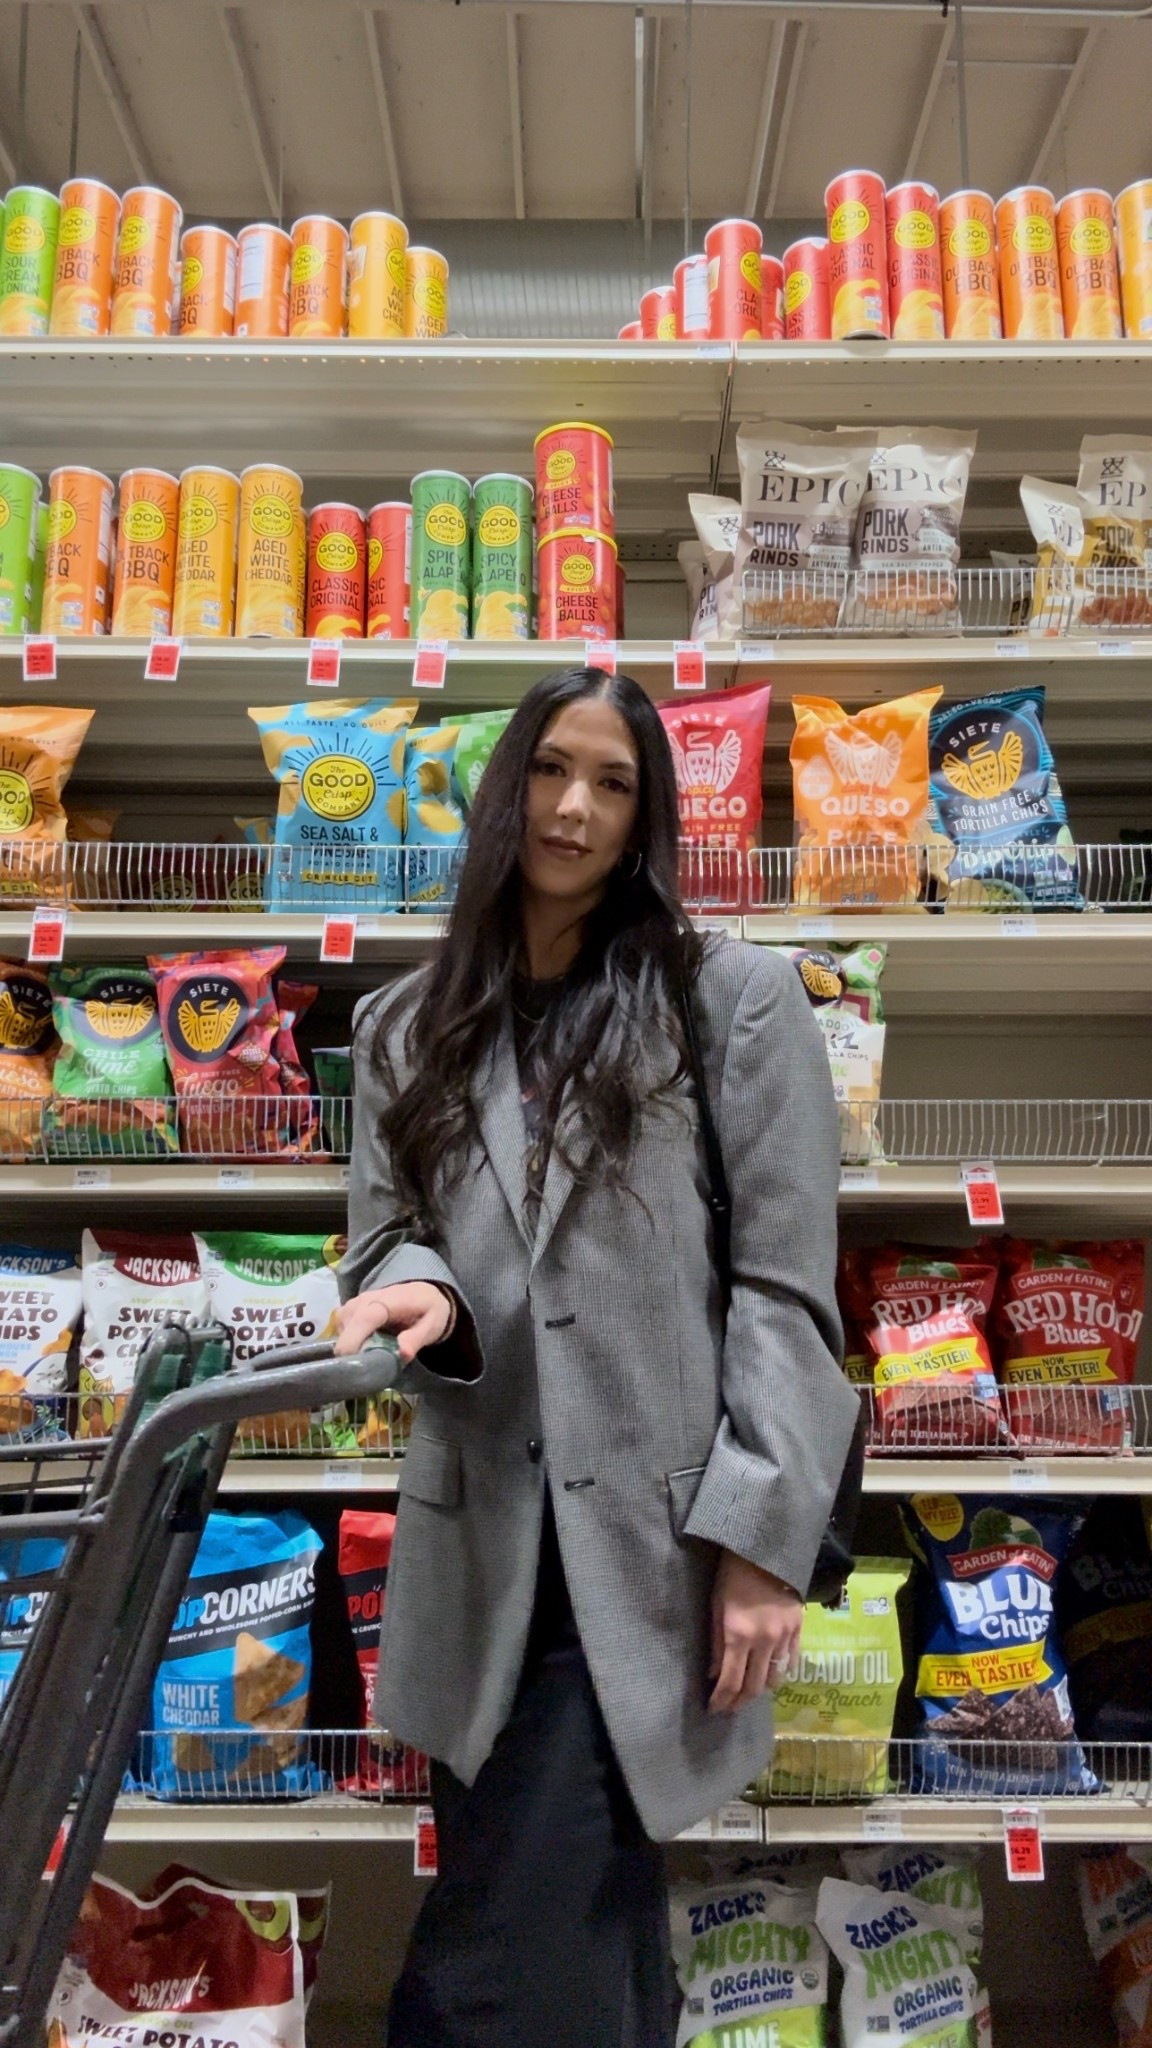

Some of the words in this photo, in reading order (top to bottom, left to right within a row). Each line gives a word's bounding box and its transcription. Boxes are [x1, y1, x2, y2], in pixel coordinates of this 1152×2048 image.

[5, 257, 38, 268] SOUR
[758, 473, 863, 507] EPIC
[865, 468, 963, 495] EPIC
[542, 488, 582, 507] CHEESE
[125, 513, 163, 524] GOOD
[253, 507, 291, 520] GOOD
[544, 500, 578, 519] BALLS
[481, 518, 518, 529] GOOD
[862, 508, 909, 539] PORK
[753, 521, 801, 550] PORK
[253, 539, 287, 555] AGED
[319, 544, 355, 555] GOOD
[861, 538, 909, 555] RINDS
[250, 555, 289, 573] WHITE
[564, 563, 591, 571] GOOD
[750, 548, 799, 567] RINDS
[122, 560, 160, 583] BBQ
[245, 568, 292, 586] CHEDDAR
[312, 577, 359, 595] CLASSIC
[310, 592, 360, 611] ORIGINAL
[556, 595, 599, 609] CHEESE
[559, 608, 596, 621] BALLS
[361, 719, 387, 728] GUILT
[672, 713, 727, 728] SIETE
[948, 722, 1001, 749] SIETE
[330, 765, 346, 774] The
[309, 773, 368, 788] GOOD
[323, 789, 352, 800] Crisp
[687, 786, 715, 797] spicy
[317, 797, 362, 812] COMPANY
[821, 795, 910, 817] QUESO
[962, 801, 998, 817] GRAIN
[1002, 790, 1032, 810] FREE
[953, 814, 1007, 832] TORTILLA
[1012, 799, 1049, 821] CHIPS
[301, 825, 328, 840] SEA
[332, 826, 365, 842] SALT
[370, 827, 379, 841] &
[710, 823, 741, 832] FREE
[12, 985, 52, 1008] SIETE
[100, 984, 144, 998] SIETE
[189, 983, 229, 998] SIETE
[83, 1049, 141, 1059] CHILE
[848, 1053, 869, 1061] CHIPS
[113, 1085, 137, 1094] CHIPS
[0, 1256, 67, 1273] CKSON'S
[235, 1258, 317, 1283] JACKSON'S
[883, 1280, 929, 1292] GARDEN
[931, 1281, 938, 1291] of
[1017, 1273, 1064, 1289] GARDEN
[1064, 1271, 1073, 1285] of
[0, 1307, 58, 1323] TATO
[231, 1303, 307, 1323] SWEET
[870, 1296, 933, 1330] RED
[1003, 1290, 1066, 1333] RED
[107, 1325, 152, 1340] POT
[228, 1321, 316, 1342] POTATO
[908, 1315, 969, 1343] Blues
[1044, 1323, 1101, 1345] Blues
[911, 1350, 932, 1362] NOW
[1042, 1357, 1065, 1367] NOW
[882, 1364, 912, 1381] EVEN
[1008, 1366, 1043, 1383] EVEN
[1046, 1361, 1100, 1378] TASTIER!
[954, 1551, 1007, 1571] GARDEN
[1008, 1550, 1019, 1560] of
[1022, 1549, 1054, 1572] EATIN'
[199, 1628, 213, 1637] AND
[215, 1619, 258, 1633] WHOLESOME
[259, 1604, 301, 1623] POPPED-CORN
[979, 1612, 1050, 1642] Chips
[786, 1649, 856, 1684] OCADO
[863, 1649, 896, 1684] OIL
[971, 1654, 1000, 1668] NOW
[936, 1671, 972, 1688] EVEN
[163, 1682, 220, 1708] WHITE
[776, 1686, 821, 1708] Lime
[825, 1688, 883, 1711] Ranch
[162, 1706, 220, 1726] CHEDDAR
[688, 1891, 767, 1936] ZACK'S
[845, 1905, 918, 1950] ZACK'S
[686, 1921, 811, 1983] MIGHTY
[129, 1975, 211, 2009] JACKSON'S
[710, 1967, 794, 2000] ORGANIC
[713, 1993, 761, 2016] TORTILLA
[763, 1988, 793, 2003] CHIPS
[893, 1976, 963, 2017] ORGANIC
[899, 2009, 938, 2034] TORTILLA
[938, 2000, 964, 2017] CHIPS
[78, 2015, 140, 2043] SWEET
